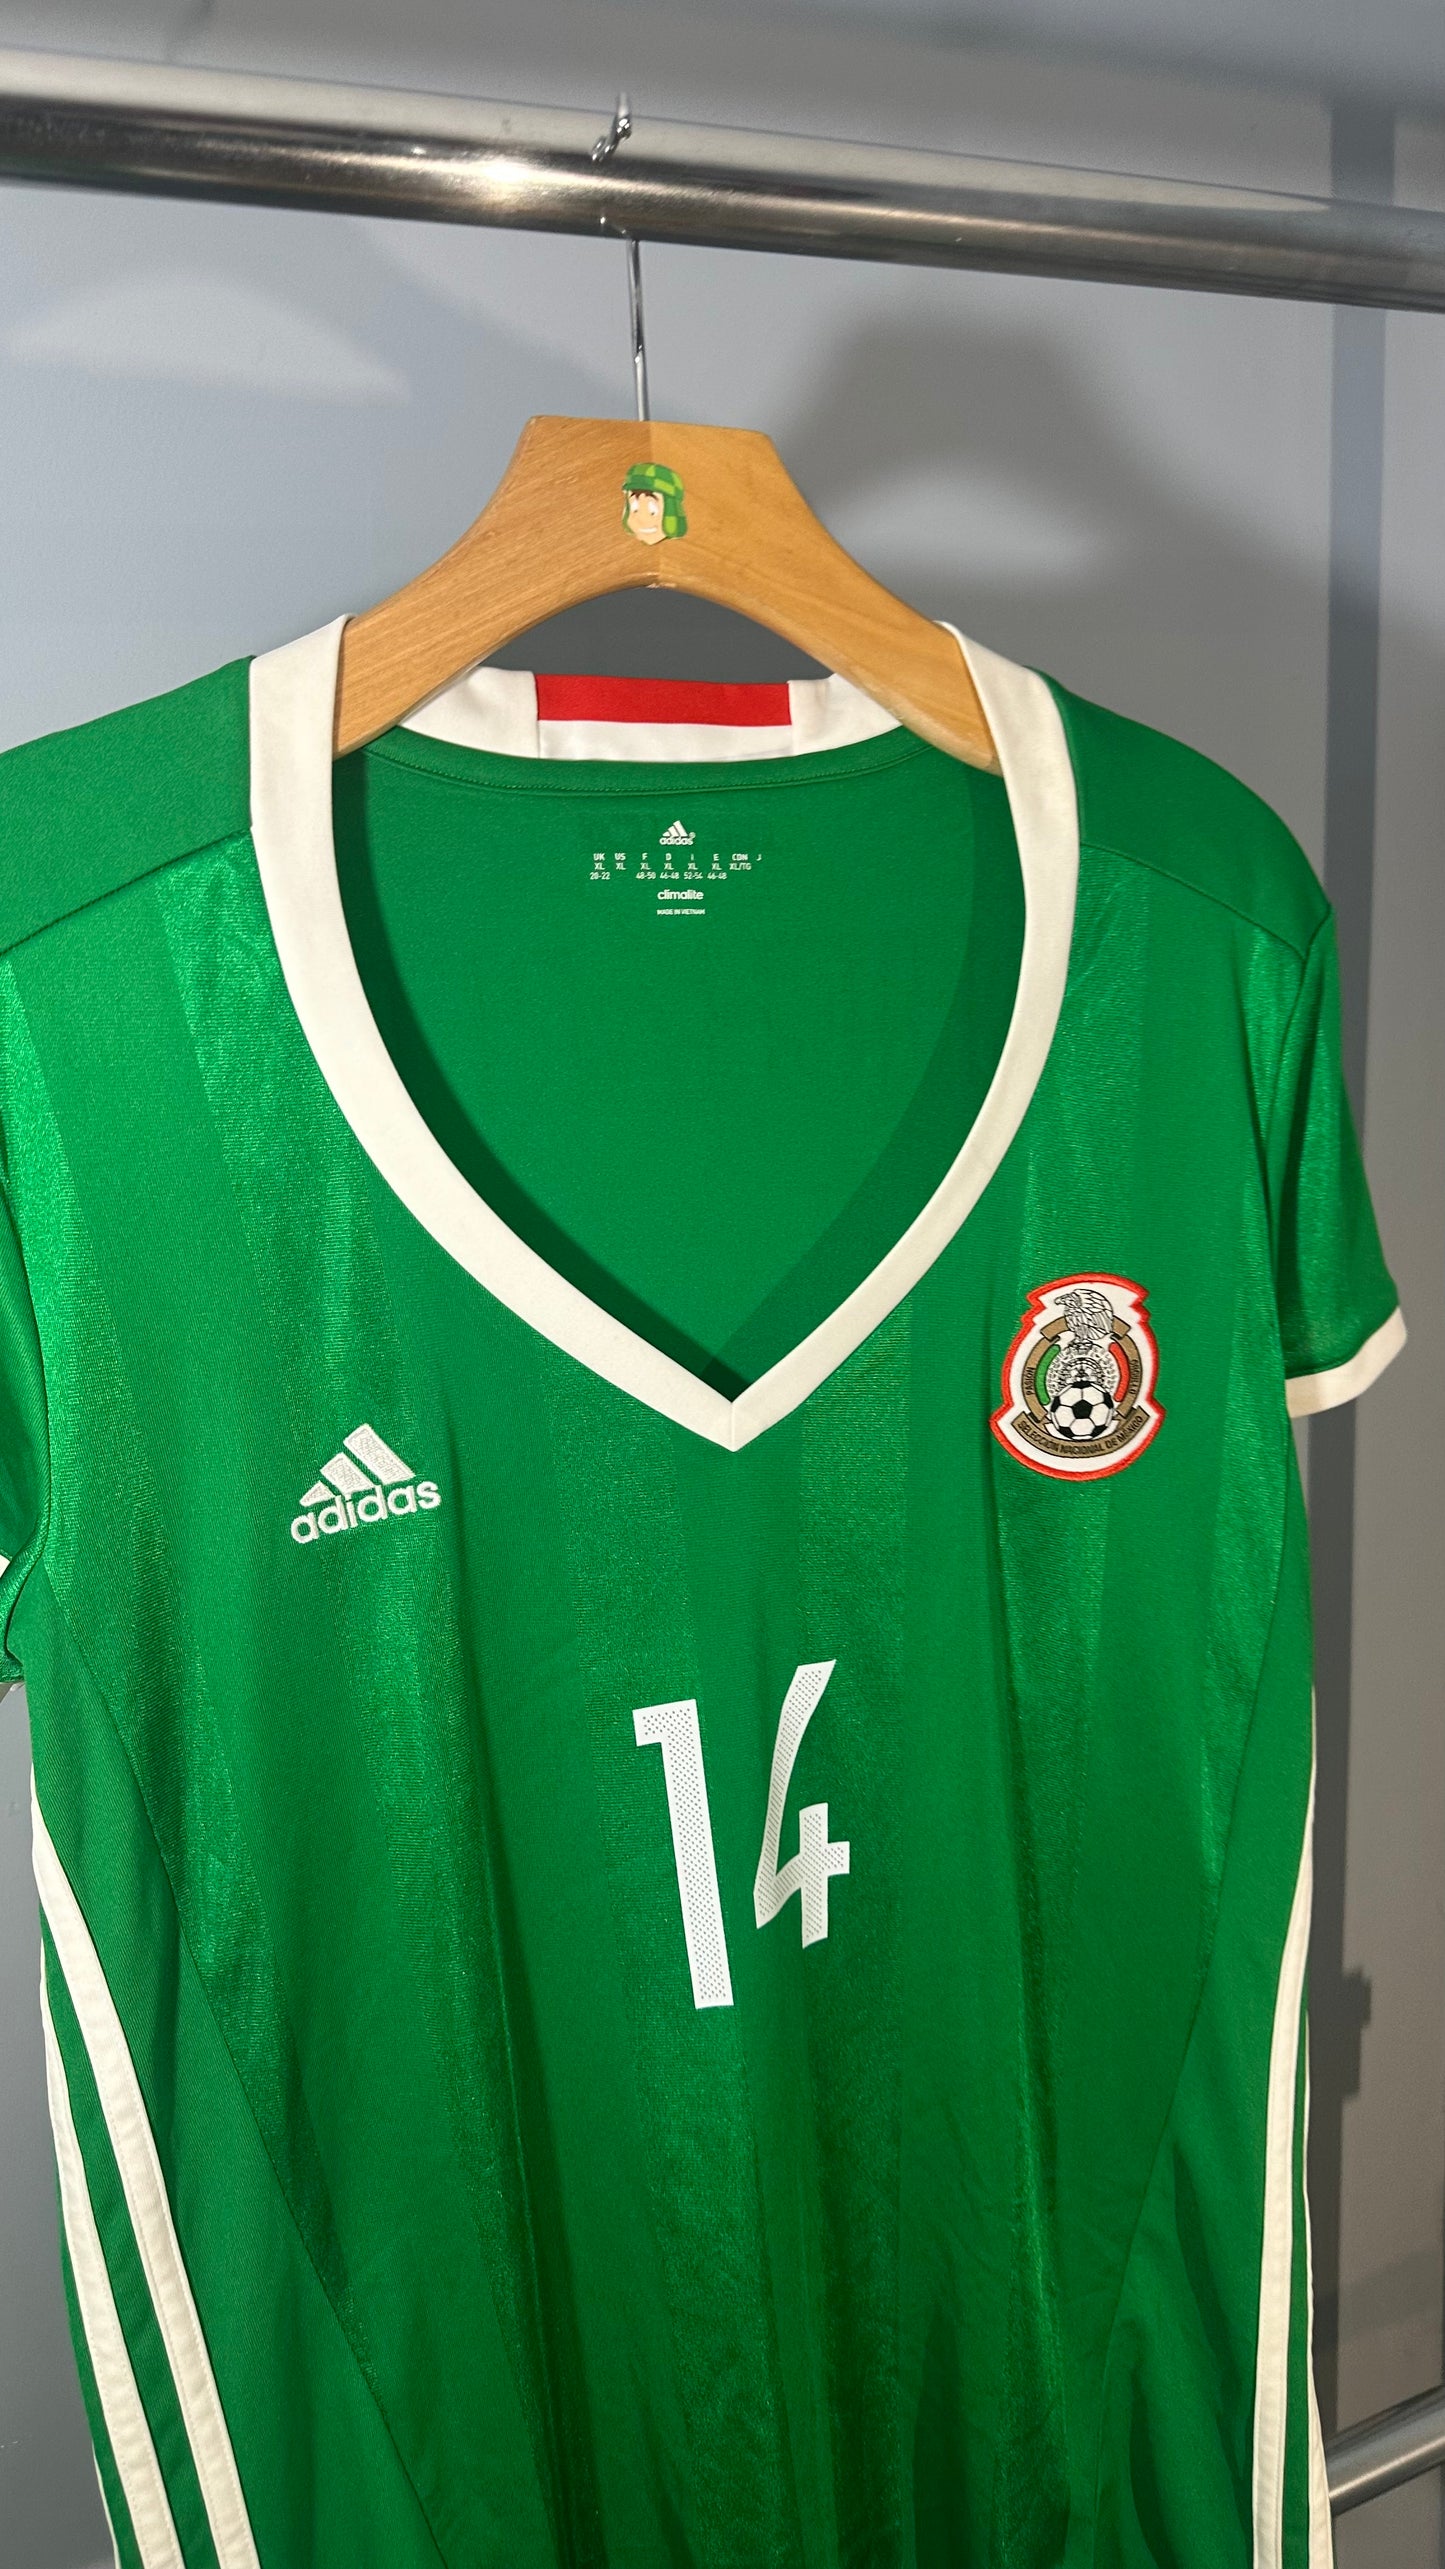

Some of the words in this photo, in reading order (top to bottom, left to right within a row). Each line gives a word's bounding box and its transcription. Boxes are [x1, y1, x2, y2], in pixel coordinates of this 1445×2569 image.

[659, 836, 693, 846] adidas
[593, 853, 606, 861] UK
[614, 853, 627, 861] US
[641, 853, 648, 861] F
[665, 853, 672, 861] D
[713, 853, 720, 861] E
[731, 853, 749, 861] CDN
[594, 862, 606, 871] XL
[615, 862, 627, 871] XL
[640, 862, 652, 871] XL
[664, 862, 675, 871] XL
[687, 862, 699, 871] XL
[711, 862, 723, 871] XL
[729, 862, 752, 871] XL/TG
[590, 871, 611, 880] 20-22
[635, 871, 656, 880] 48-50
[659, 871, 680, 880] 46-48
[683, 871, 703, 880] 52-54
[707, 871, 728, 880] 46-48
[657, 889, 704, 900] climalite
[1105, 1440, 1118, 1449] DE
[290, 1481, 442, 1544] adidas
[632, 1659, 850, 2010] 14
